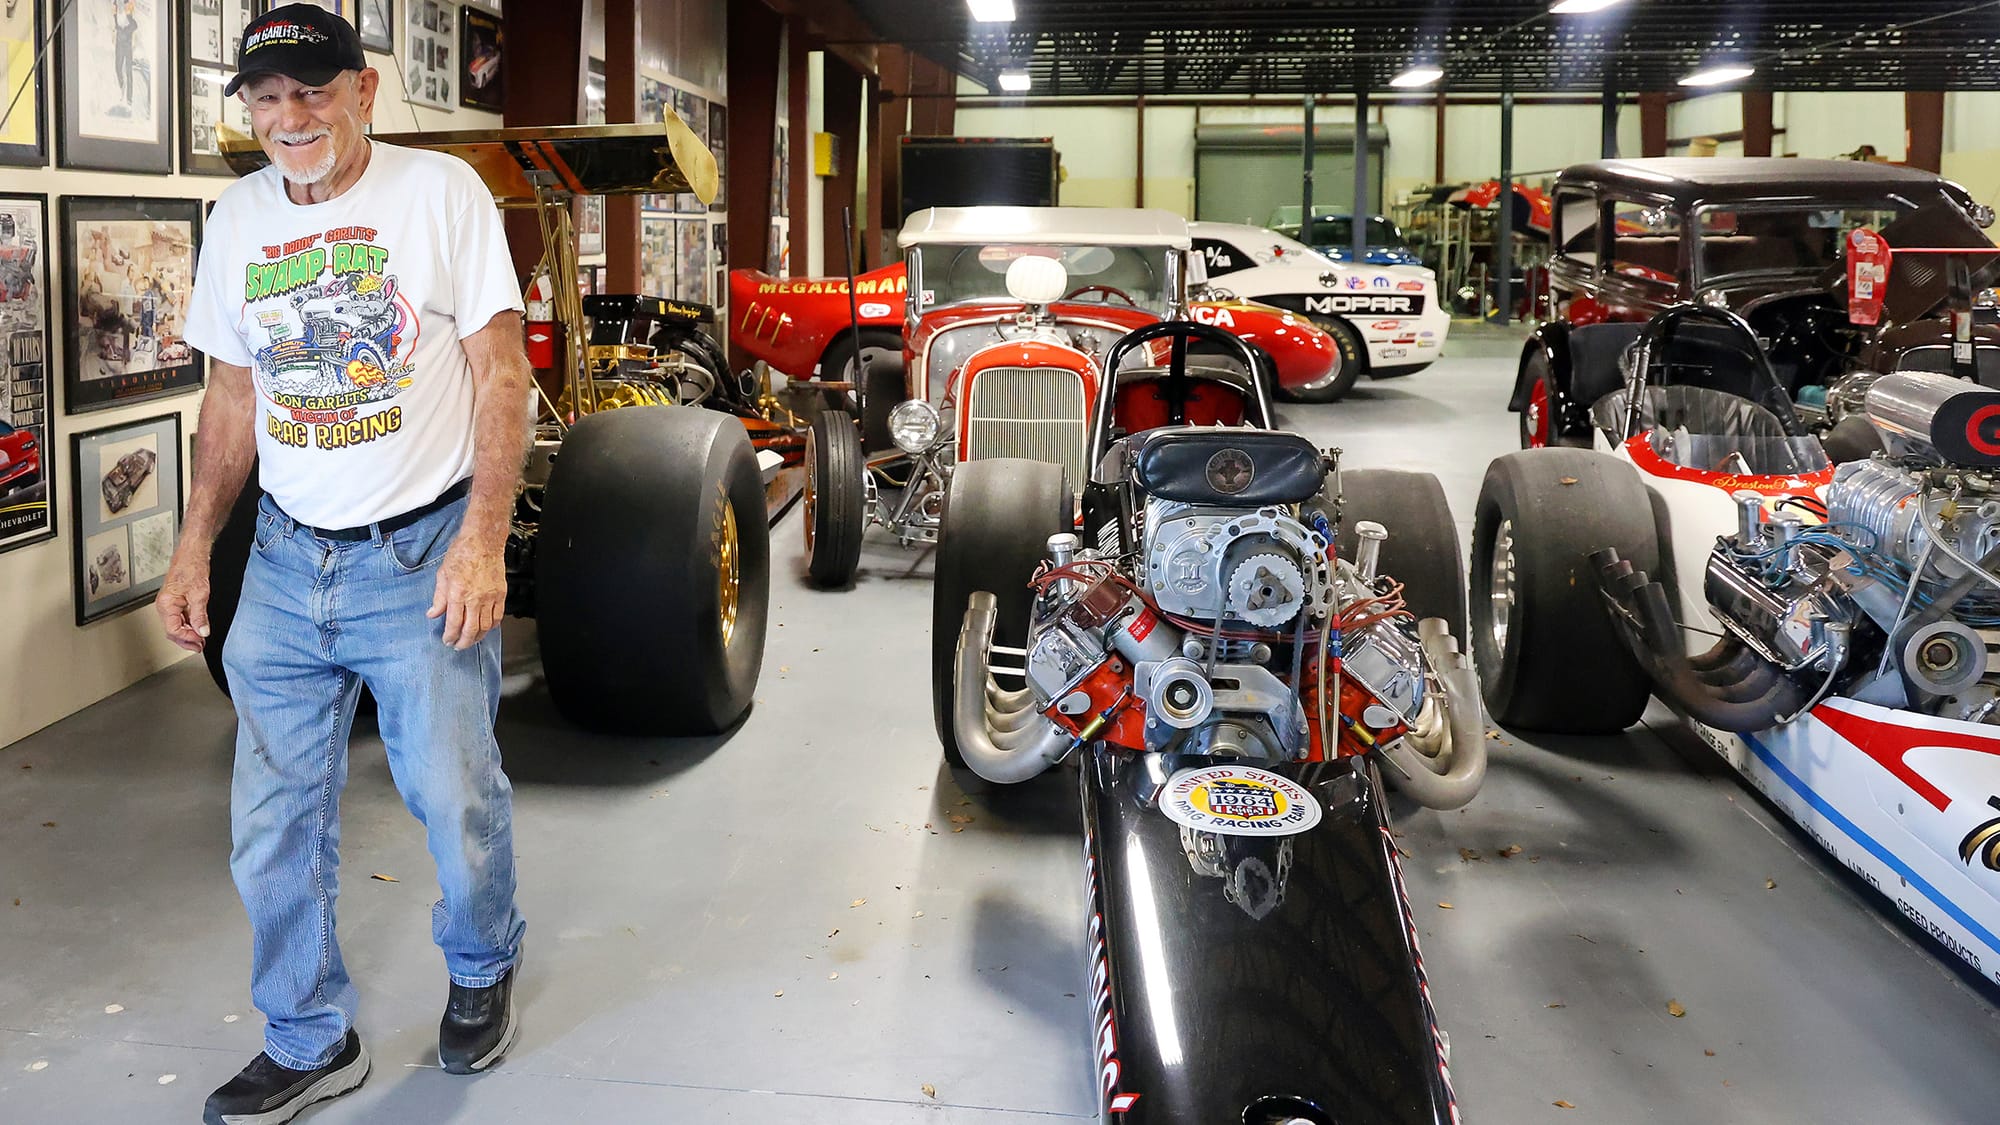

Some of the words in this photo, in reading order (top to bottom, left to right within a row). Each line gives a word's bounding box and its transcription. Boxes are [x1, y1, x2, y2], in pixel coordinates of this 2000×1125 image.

[245, 248, 326, 303] SWAMP
[333, 243, 388, 278] RAT
[1305, 296, 1412, 313] MOPAR
[274, 391, 303, 408] DON
[291, 410, 339, 424] MUSEUM
[340, 407, 358, 422] OF
[266, 409, 308, 448] DRAG
[315, 406, 402, 450] RACING
[1713, 476, 1773, 490] Preston
[0, 511, 42, 529] HEVROLET
[1173, 770, 1233, 795] UNITED
[1244, 770, 1303, 800] STATES
[1216, 795, 1273, 807] 1964
[1174, 800, 1205, 821] DRAG
[1210, 817, 1283, 829] RACING
[1281, 803, 1306, 824] TEAM
[1896, 897, 1929, 930] SPEED
[1929, 920, 1982, 971] PRODUCTS
